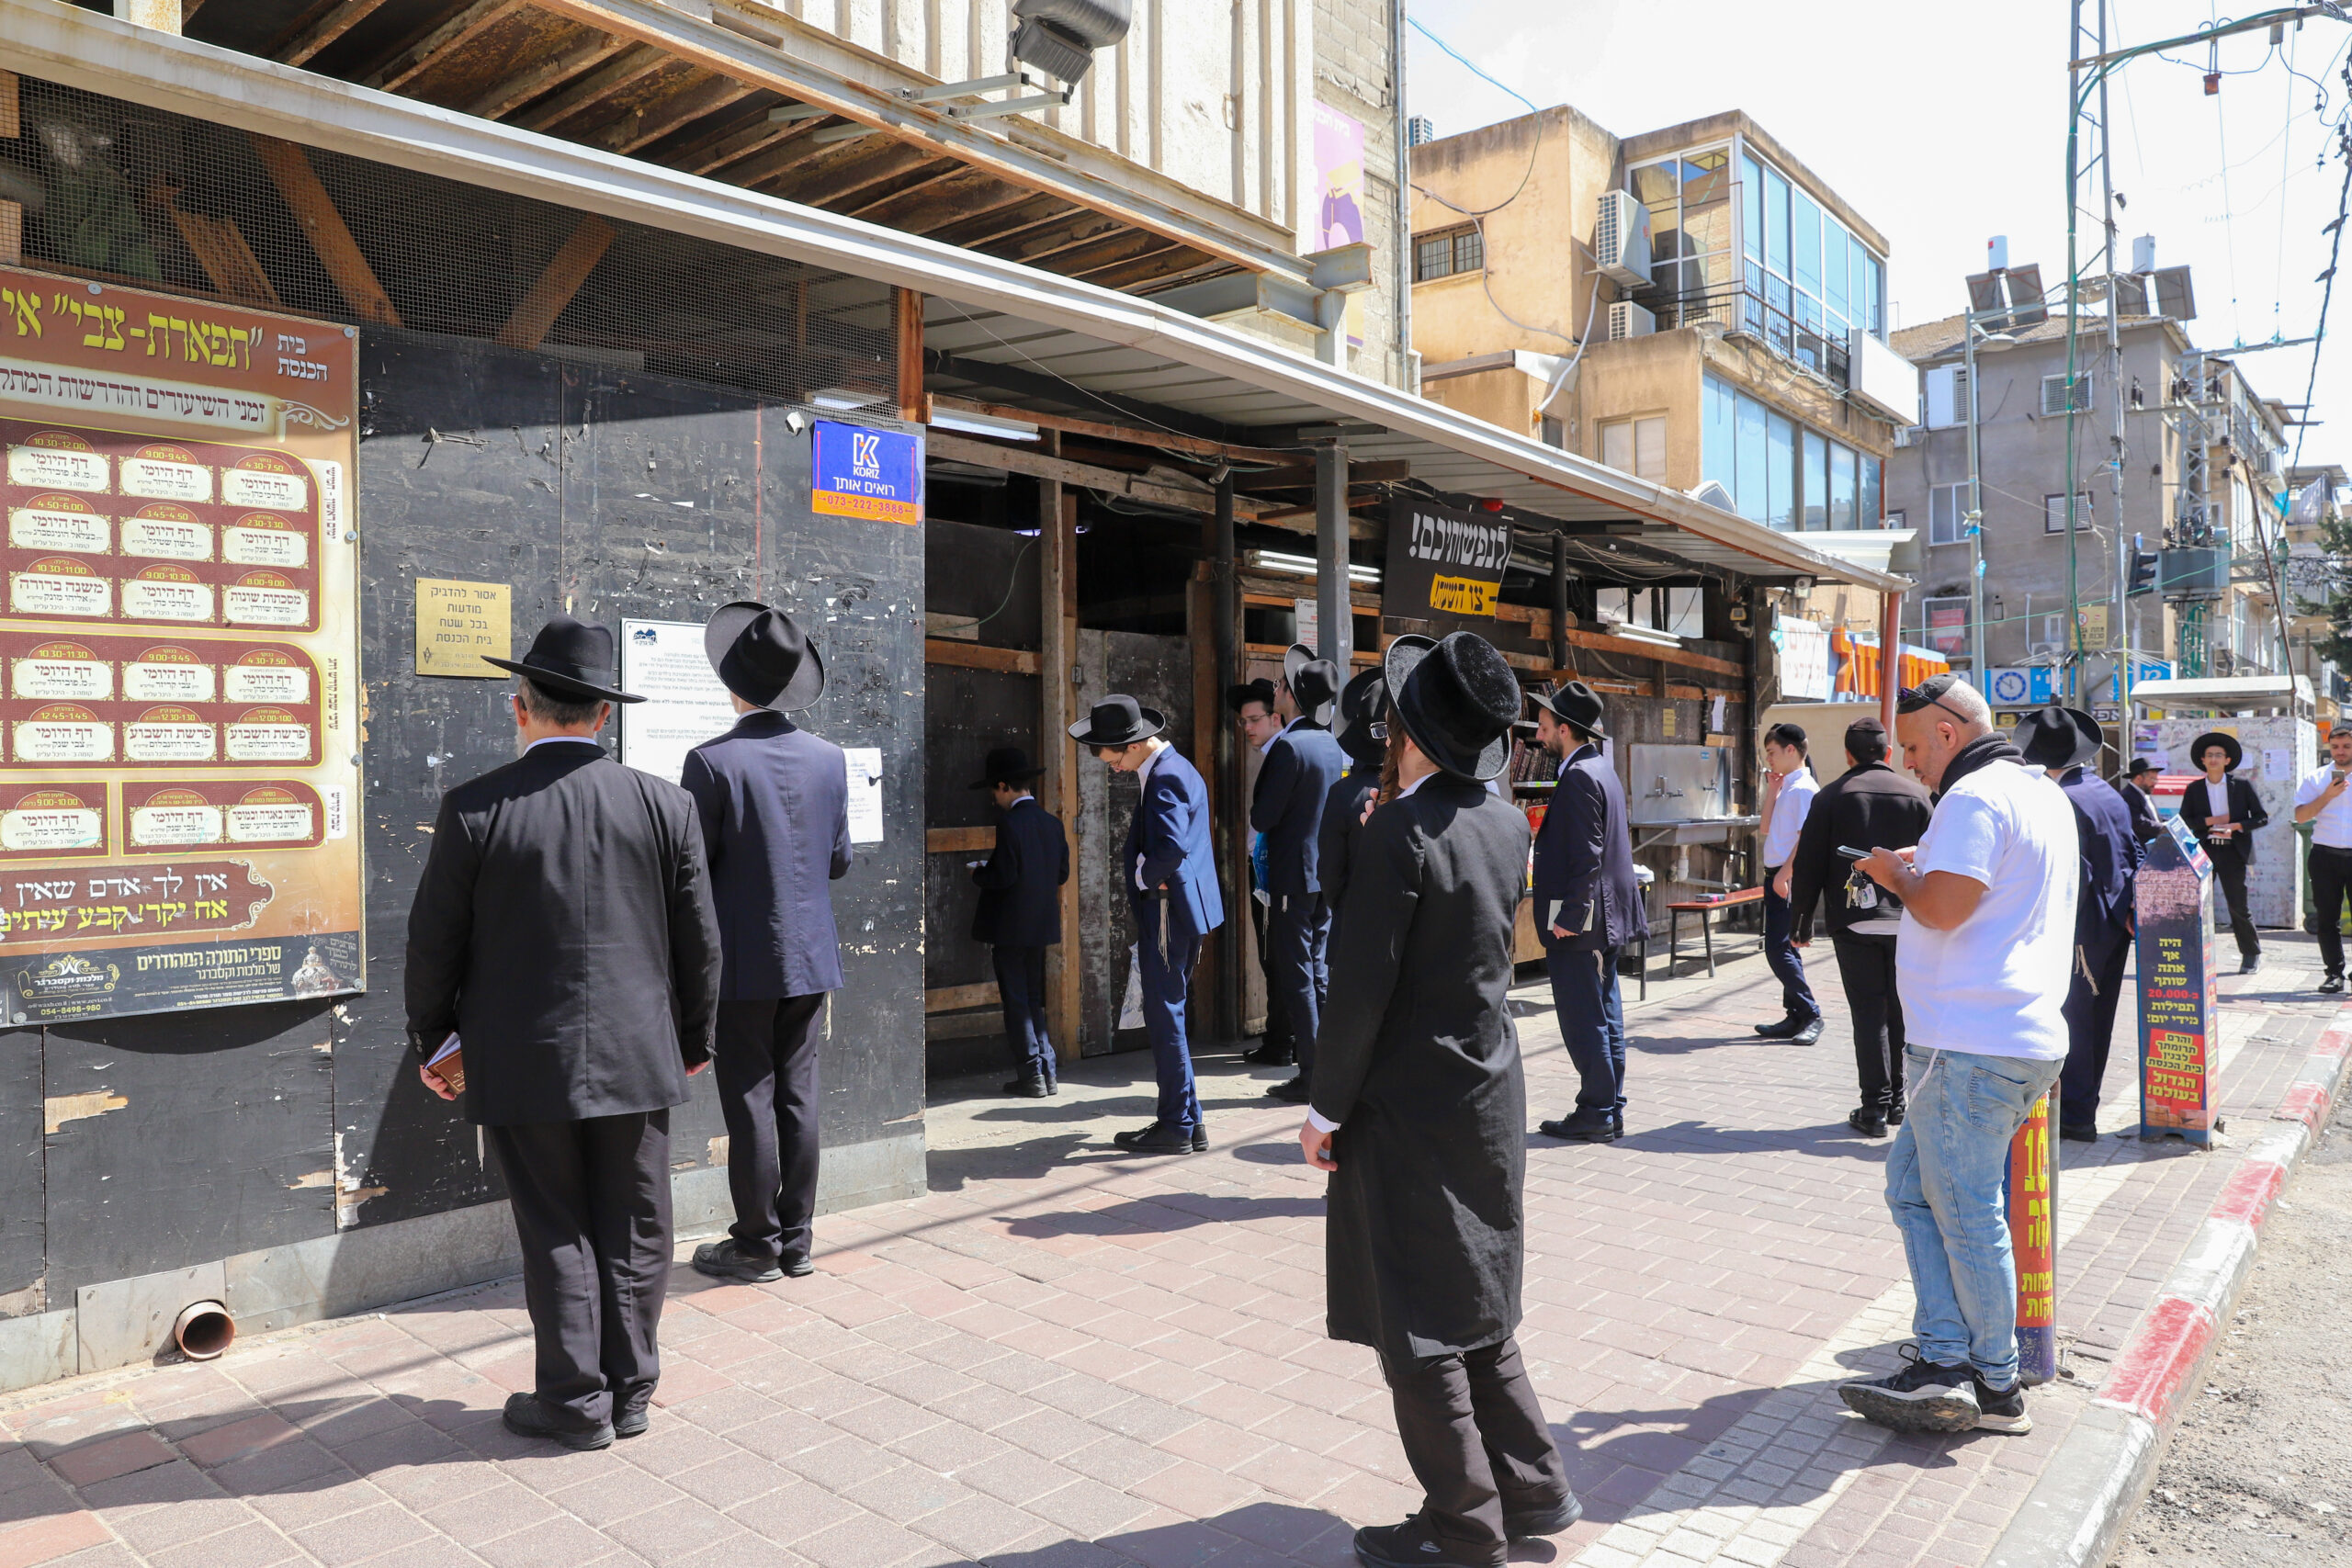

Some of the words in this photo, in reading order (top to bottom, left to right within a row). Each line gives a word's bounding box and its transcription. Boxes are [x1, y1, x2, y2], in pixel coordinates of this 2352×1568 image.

[277, 333, 307, 355] בית
[277, 356, 328, 381] הכנסת
[58, 374, 141, 407] והדרשות
[147, 389, 230, 419] השיעורים
[234, 399, 266, 423] זמני
[853, 466, 880, 479] KORIZ
[832, 477, 861, 491] אותך
[865, 481, 895, 497] רואים
[827, 495, 904, 514] 073-222-3888
[19, 579, 62, 591] ברורה
[65, 581, 104, 593] משנה
[231, 592, 260, 603] שונות
[431, 587, 467, 598] להדביק
[474, 590, 497, 600] אסור
[1469, 584, 1484, 612] צו
[263, 593, 301, 605] מסכתות
[447, 604, 481, 615] מודעות
[440, 618, 463, 628] שטח
[469, 619, 488, 629] בכל
[435, 633, 469, 643] הכנסת
[476, 635, 492, 645] בית
[130, 728, 173, 739] השבוע
[176, 728, 211, 739] פרשת
[230, 728, 270, 739] השבוע
[274, 729, 306, 739] פרשת
[89, 877, 141, 897] אדם
[153, 866, 183, 899] לך
[195, 873, 227, 897] אין
[16, 881, 76, 908] שאין
[195, 899, 228, 919] אח
[77, 905, 129, 931] קבע
[2159, 938, 2182, 947] היה
[206, 949, 247, 965] התורה
[250, 946, 281, 962] ספרי
[2162, 951, 2180, 962] אף
[137, 951, 203, 971] המהודרים
[236, 964, 265, 977] מלכות
[266, 963, 280, 974] של
[2157, 964, 2186, 973] אתה
[2154, 976, 2188, 987] שותף
[40, 1004, 101, 1015] 054-8498-980
[2152, 1000, 2196, 1012] תפילות
[2147, 1013, 2169, 1023] יום!
[2171, 1015, 2199, 1025] מידי
[2167, 1034, 2191, 1044] והרם
[2157, 1042, 2196, 1055] תרומתך
[2163, 1052, 2188, 1062] לבנין
[2148, 1058, 2181, 1070] הכנסת
[2184, 1064, 2202, 1074] בית
[2153, 1070, 2197, 1089] הגדול
[2147, 1084, 2199, 1102] בעולם!
